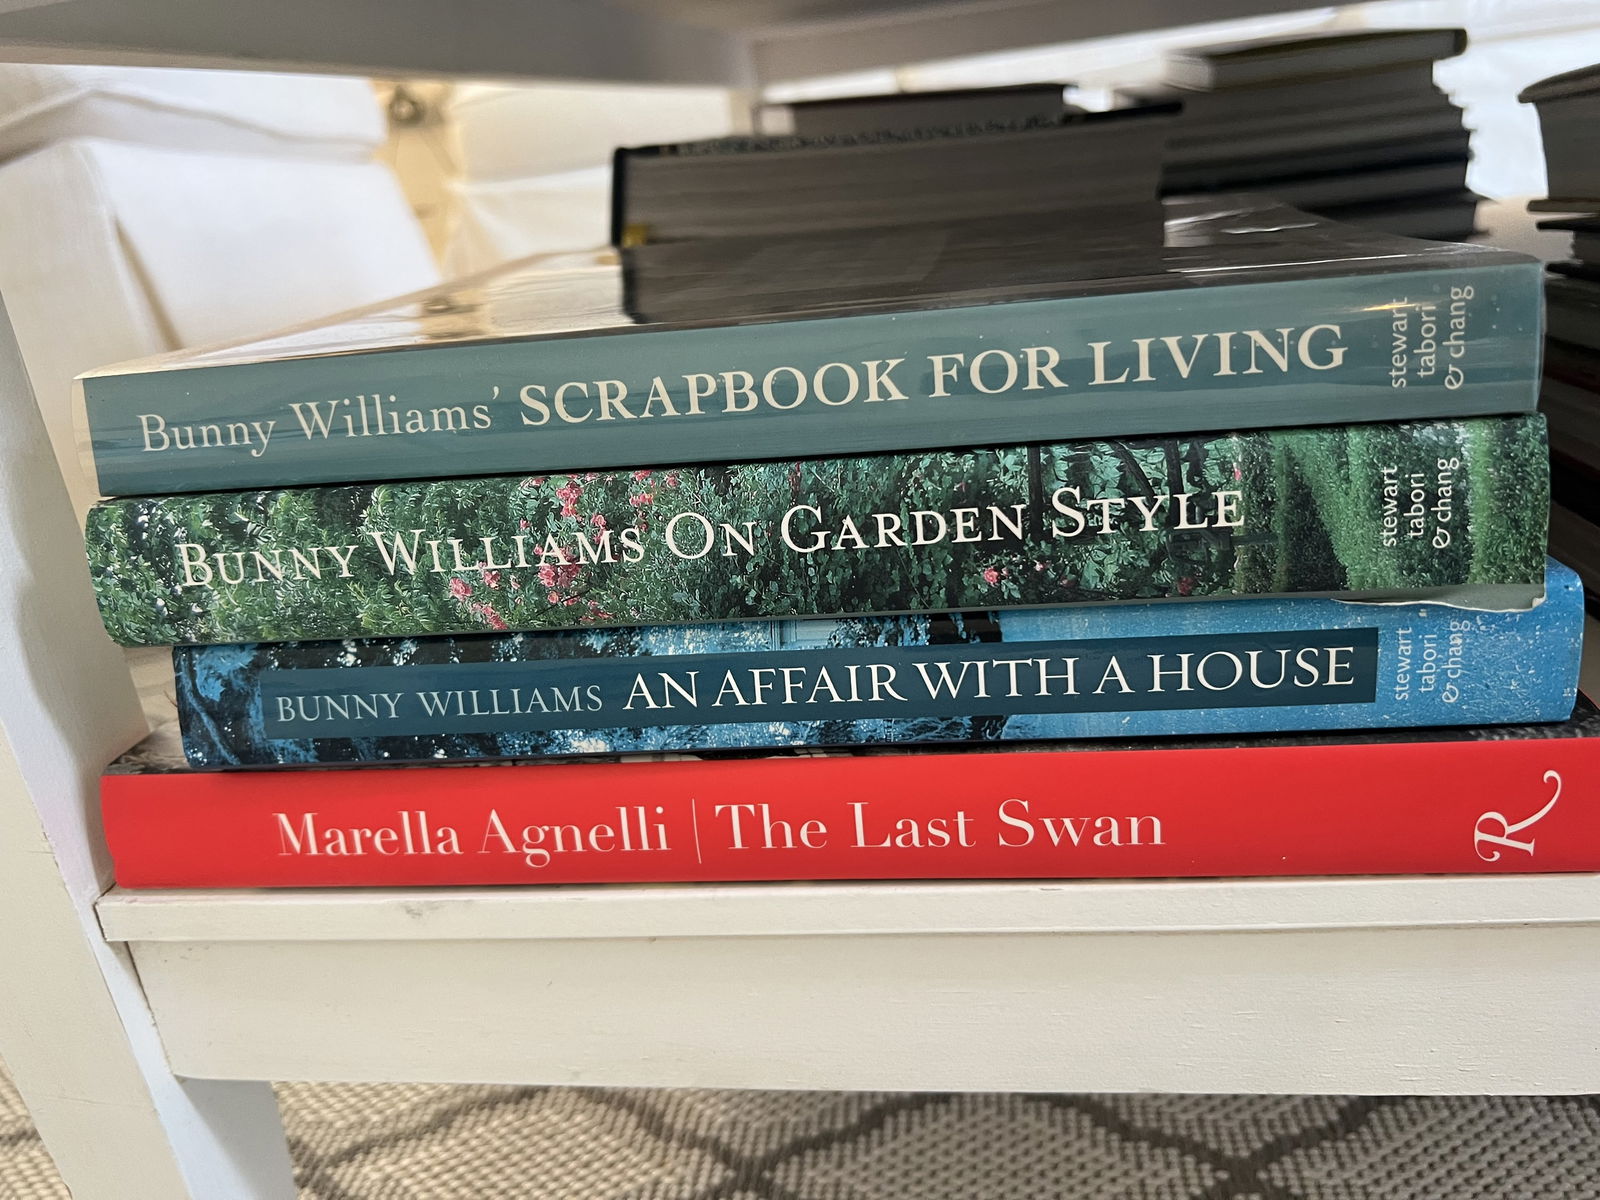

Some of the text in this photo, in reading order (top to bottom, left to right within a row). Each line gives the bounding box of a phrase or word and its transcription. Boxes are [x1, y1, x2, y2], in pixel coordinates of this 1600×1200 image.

[1388, 297, 1408, 388] stewart
[1414, 304, 1438, 378] tabori
[1442, 285, 1475, 391] & chang
[137, 323, 1349, 458] Bunny Williams' SCRAPBOOK FOR LIVING
[178, 485, 1246, 588] BUNNY WILLIAMS ON GARDEN STYLE
[1382, 465, 1399, 548] stewart
[1404, 472, 1425, 540] tabori
[1431, 457, 1460, 550] & chang
[276, 647, 1355, 724] BUNNY WILLIAMS AN AFFAIR WITH A HOUSE
[1393, 627, 1412, 702] stewart
[1416, 633, 1438, 694] tabori
[1441, 619, 1471, 704] & chang
[272, 797, 1167, 868] Marella Agnelli The Last Swan
[1474, 769, 1562, 864] R
